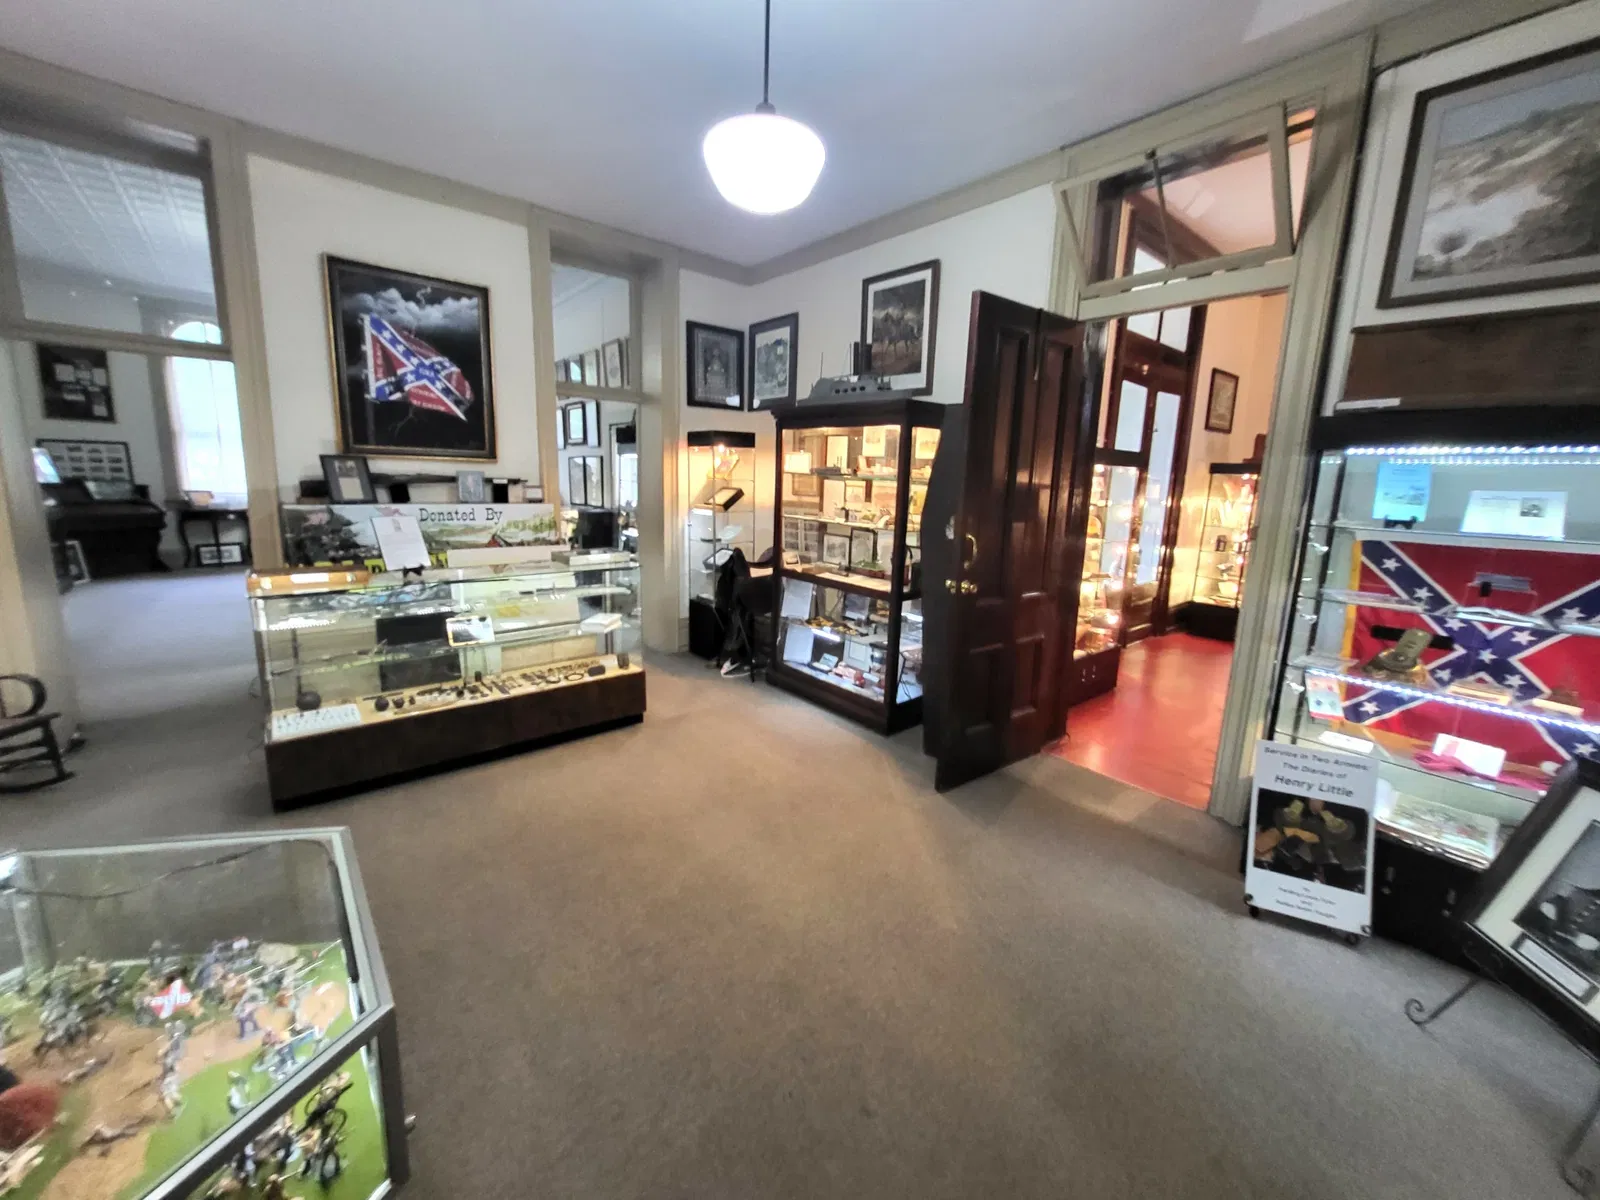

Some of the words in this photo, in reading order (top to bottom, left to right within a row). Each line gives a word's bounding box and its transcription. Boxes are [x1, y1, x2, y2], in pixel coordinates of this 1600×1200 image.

[419, 507, 476, 522] Donated
[485, 507, 503, 525] By
[1264, 746, 1298, 758] Service
[1312, 754, 1330, 764] Two
[1283, 762, 1299, 771] The
[1301, 765, 1333, 777] Diaries
[1274, 774, 1314, 791] Henry
[1318, 782, 1354, 798] Little
